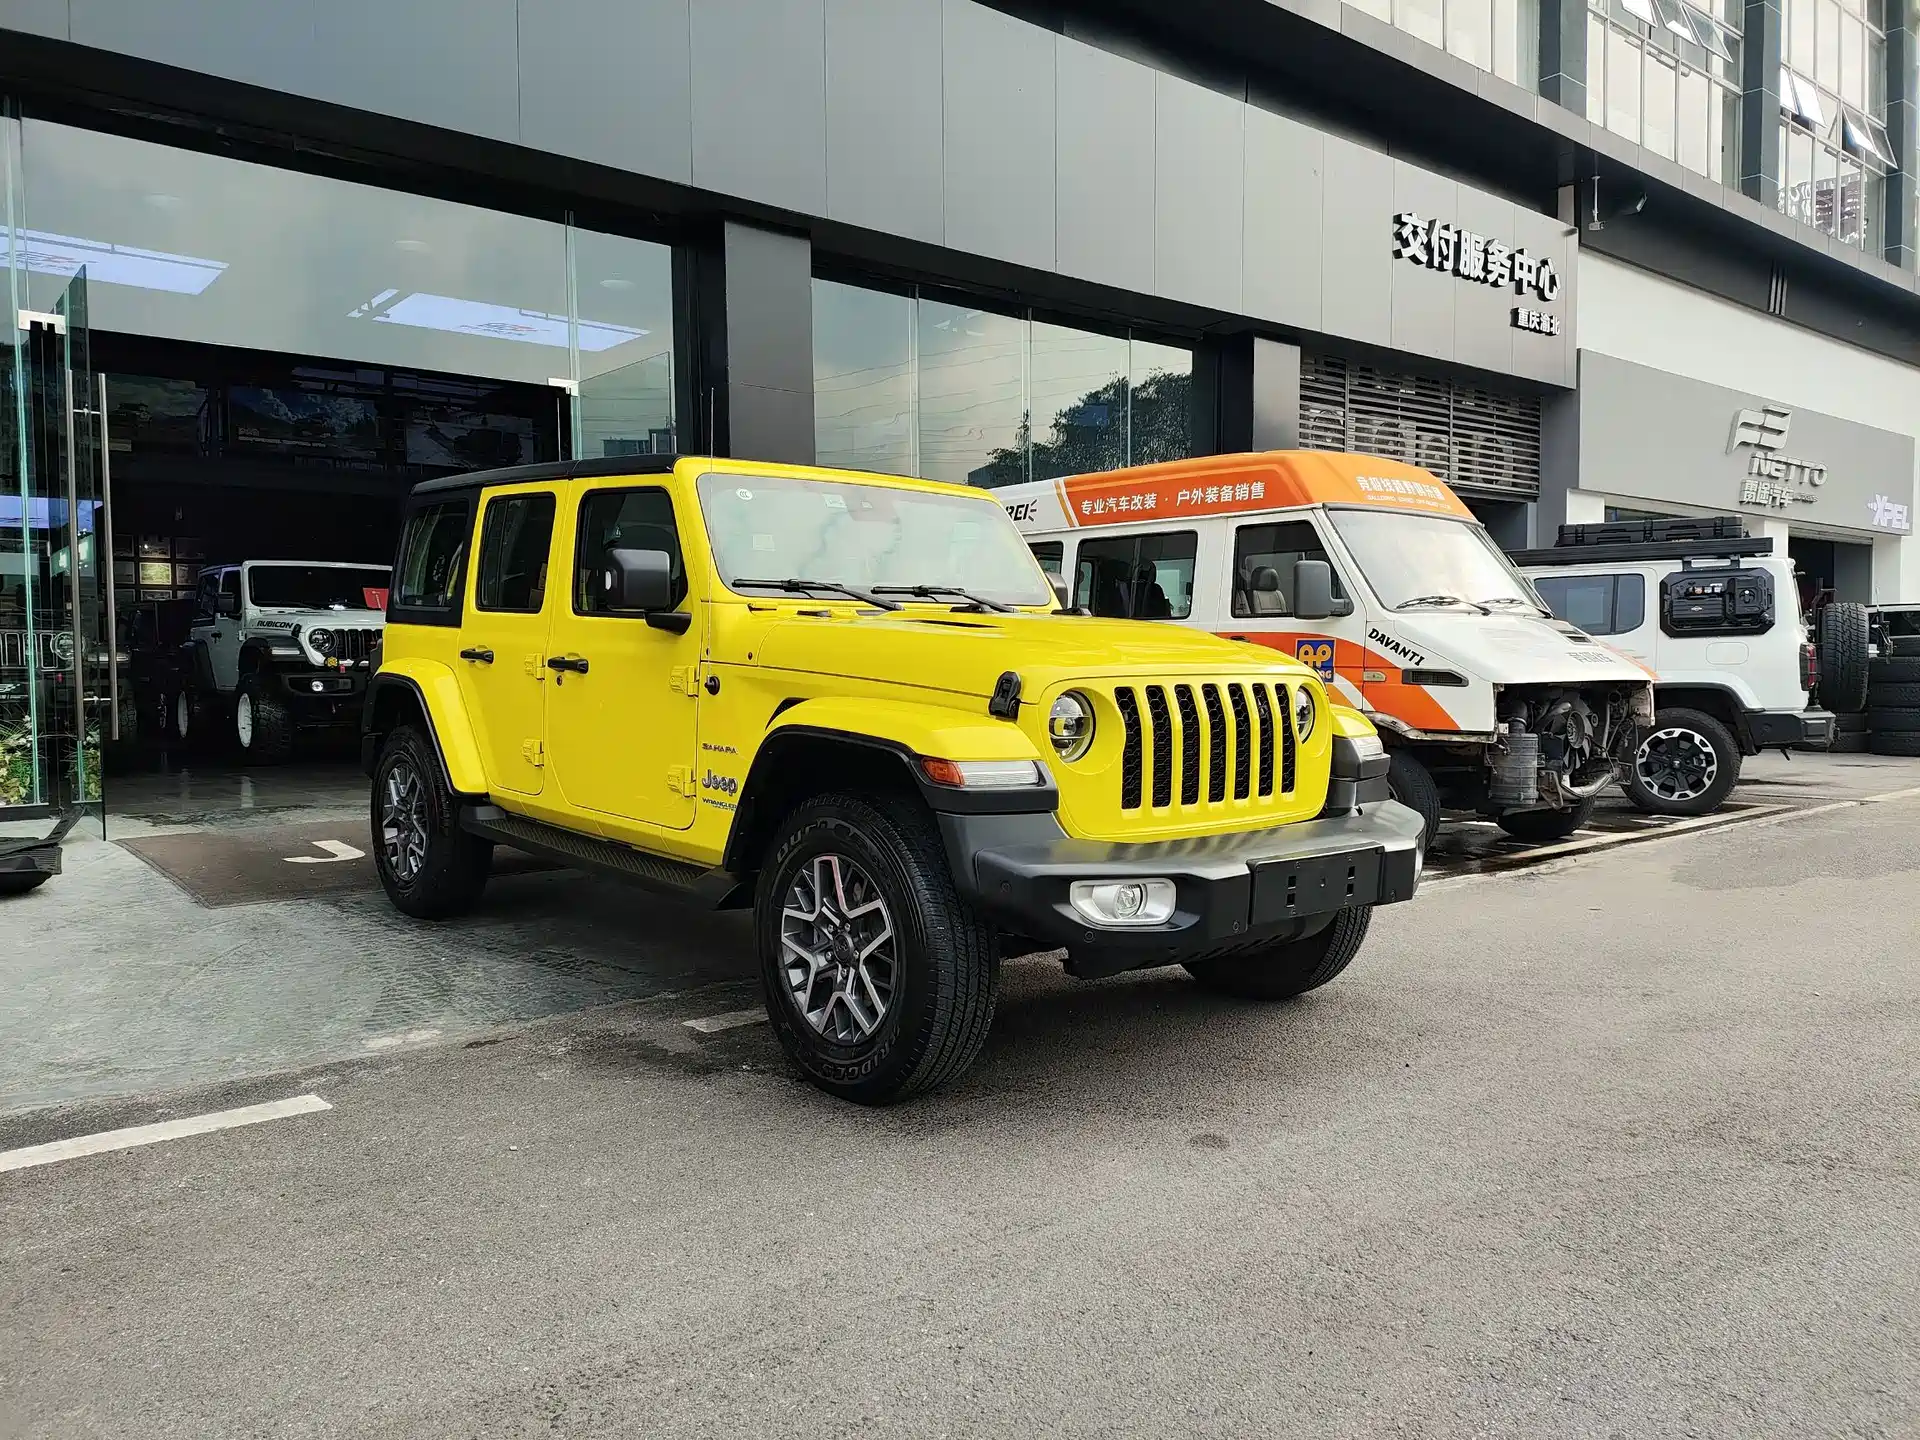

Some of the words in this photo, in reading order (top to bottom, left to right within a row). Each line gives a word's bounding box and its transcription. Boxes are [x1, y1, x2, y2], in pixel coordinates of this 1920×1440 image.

[1394, 212, 1561, 301] 交付服务中心
[1749, 452, 1828, 486] NETTO
[1080, 493, 1157, 515] 专业汽车改装
[1176, 481, 1265, 506] 户外装备销售
[1873, 494, 1909, 530] XPEL
[257, 620, 294, 629] RUBICON
[1368, 628, 1425, 666] DAVANTI
[702, 769, 738, 796] Jeep
